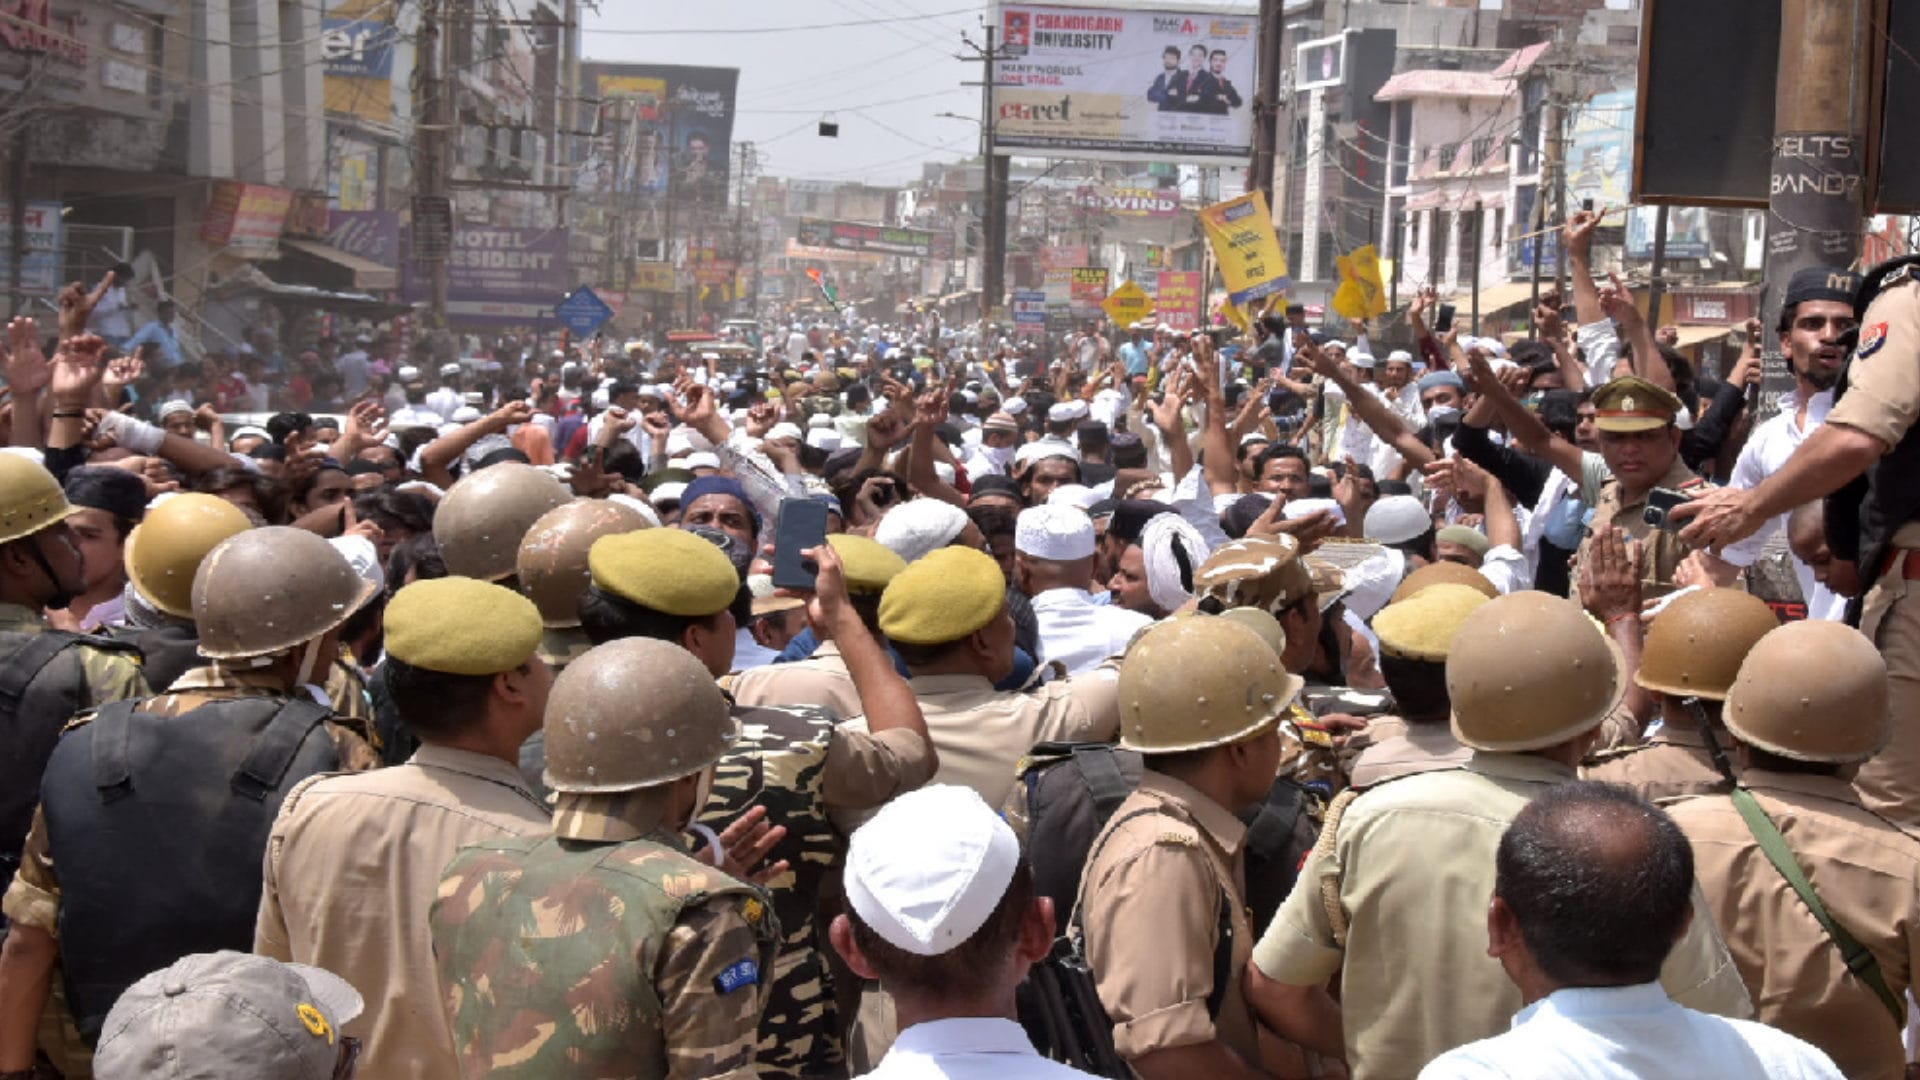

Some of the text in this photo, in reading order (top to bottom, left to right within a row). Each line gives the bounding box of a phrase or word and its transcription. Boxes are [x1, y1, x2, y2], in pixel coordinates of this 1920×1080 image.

[1035, 14, 1123, 32] CHANDIGARH
[1034, 31, 1113, 50] UNIVERSITY
[444, 250, 553, 270] ESIDENT
